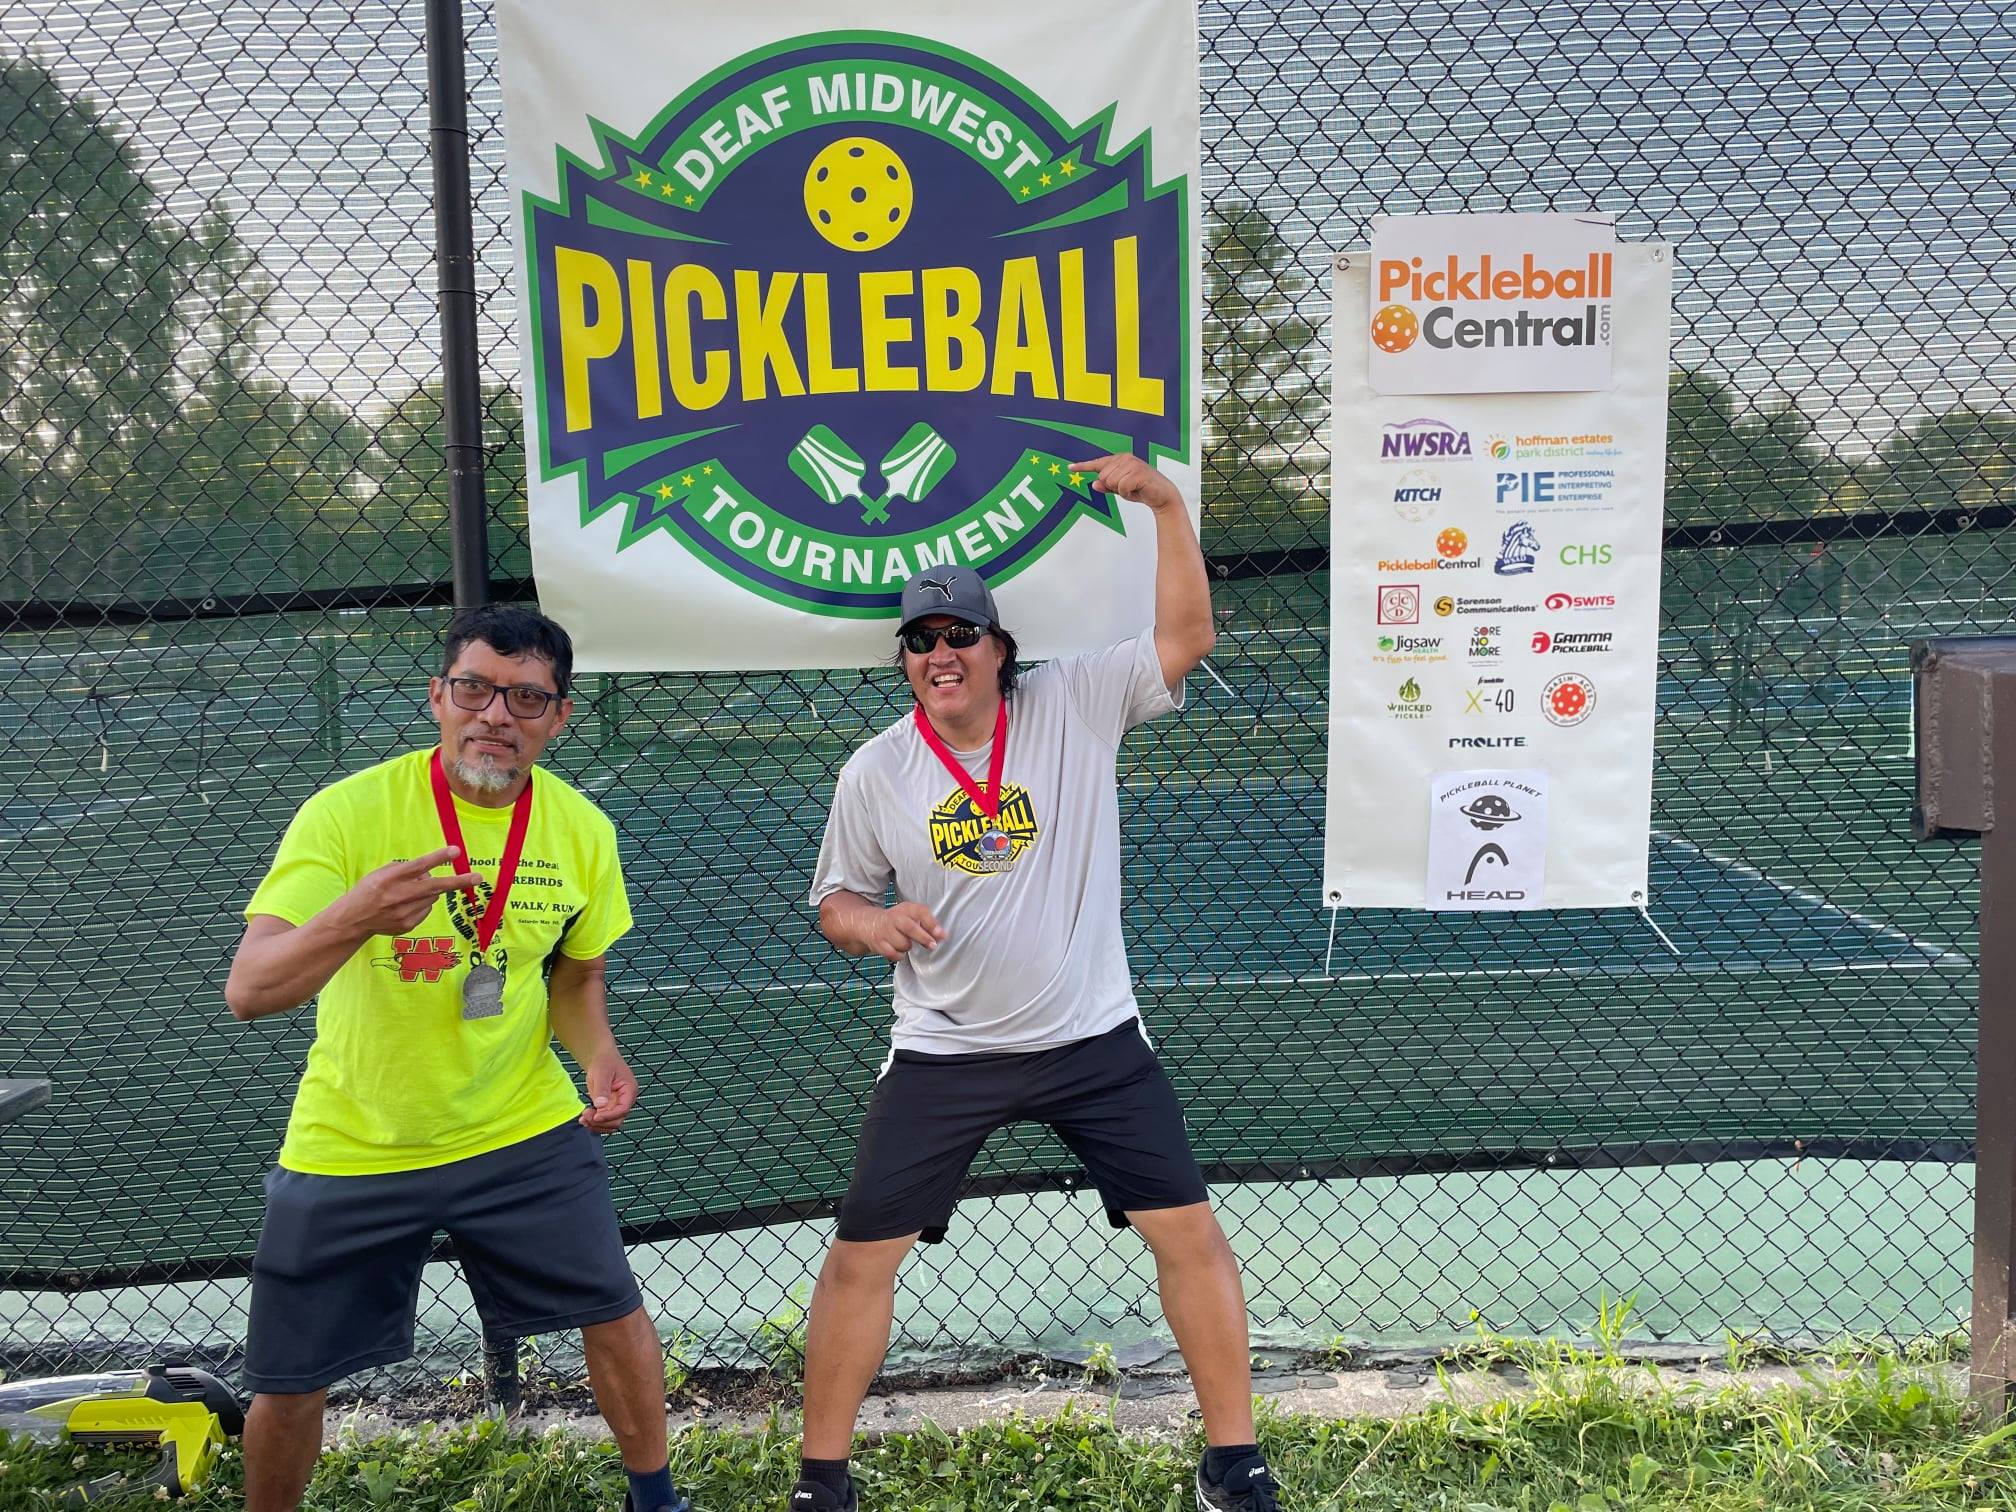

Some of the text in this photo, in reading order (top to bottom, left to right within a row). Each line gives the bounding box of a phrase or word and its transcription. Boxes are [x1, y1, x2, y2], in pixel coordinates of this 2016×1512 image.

[673, 72, 1041, 191] DEAF MIDWEST
[1379, 253, 1612, 302] Pickleball
[1422, 305, 1597, 348] Central
[555, 235, 1165, 432] PICKLEBALL
[1381, 431, 1472, 457] NWSRA
[1515, 434, 1614, 446] hoffman estates
[1515, 447, 1541, 459] park
[1543, 446, 1585, 457] district
[1558, 470, 1615, 478] PROFESSIONAL
[1496, 471, 1554, 503] PIE
[1393, 487, 1442, 502] KITCH
[1558, 493, 1602, 501] ENTERPRISE
[702, 474, 1046, 584] TOURNAMENT
[1560, 544, 1612, 566] CHS
[1456, 597, 1502, 606] Sorenson
[1573, 595, 1616, 607] SWITS
[1456, 604, 1535, 615] Communications
[1473, 626, 1501, 637] SORE
[1393, 635, 1441, 652] Jigsaw
[1471, 637, 1489, 646] NO
[1469, 647, 1501, 656] MORE
[1551, 644, 1611, 653] PICKLEBALL
[1387, 702, 1432, 712] WHICKED
[1449, 736, 1525, 748] PROLITE
[1440, 779, 1542, 802] PICKLEBALL PLANET
[469, 857, 496, 867] hool
[979, 861, 1013, 871] SECOND
[512, 876, 564, 888] REBIRDS
[1447, 890, 1525, 901] HEAD
[551, 902, 575, 914] RUN
